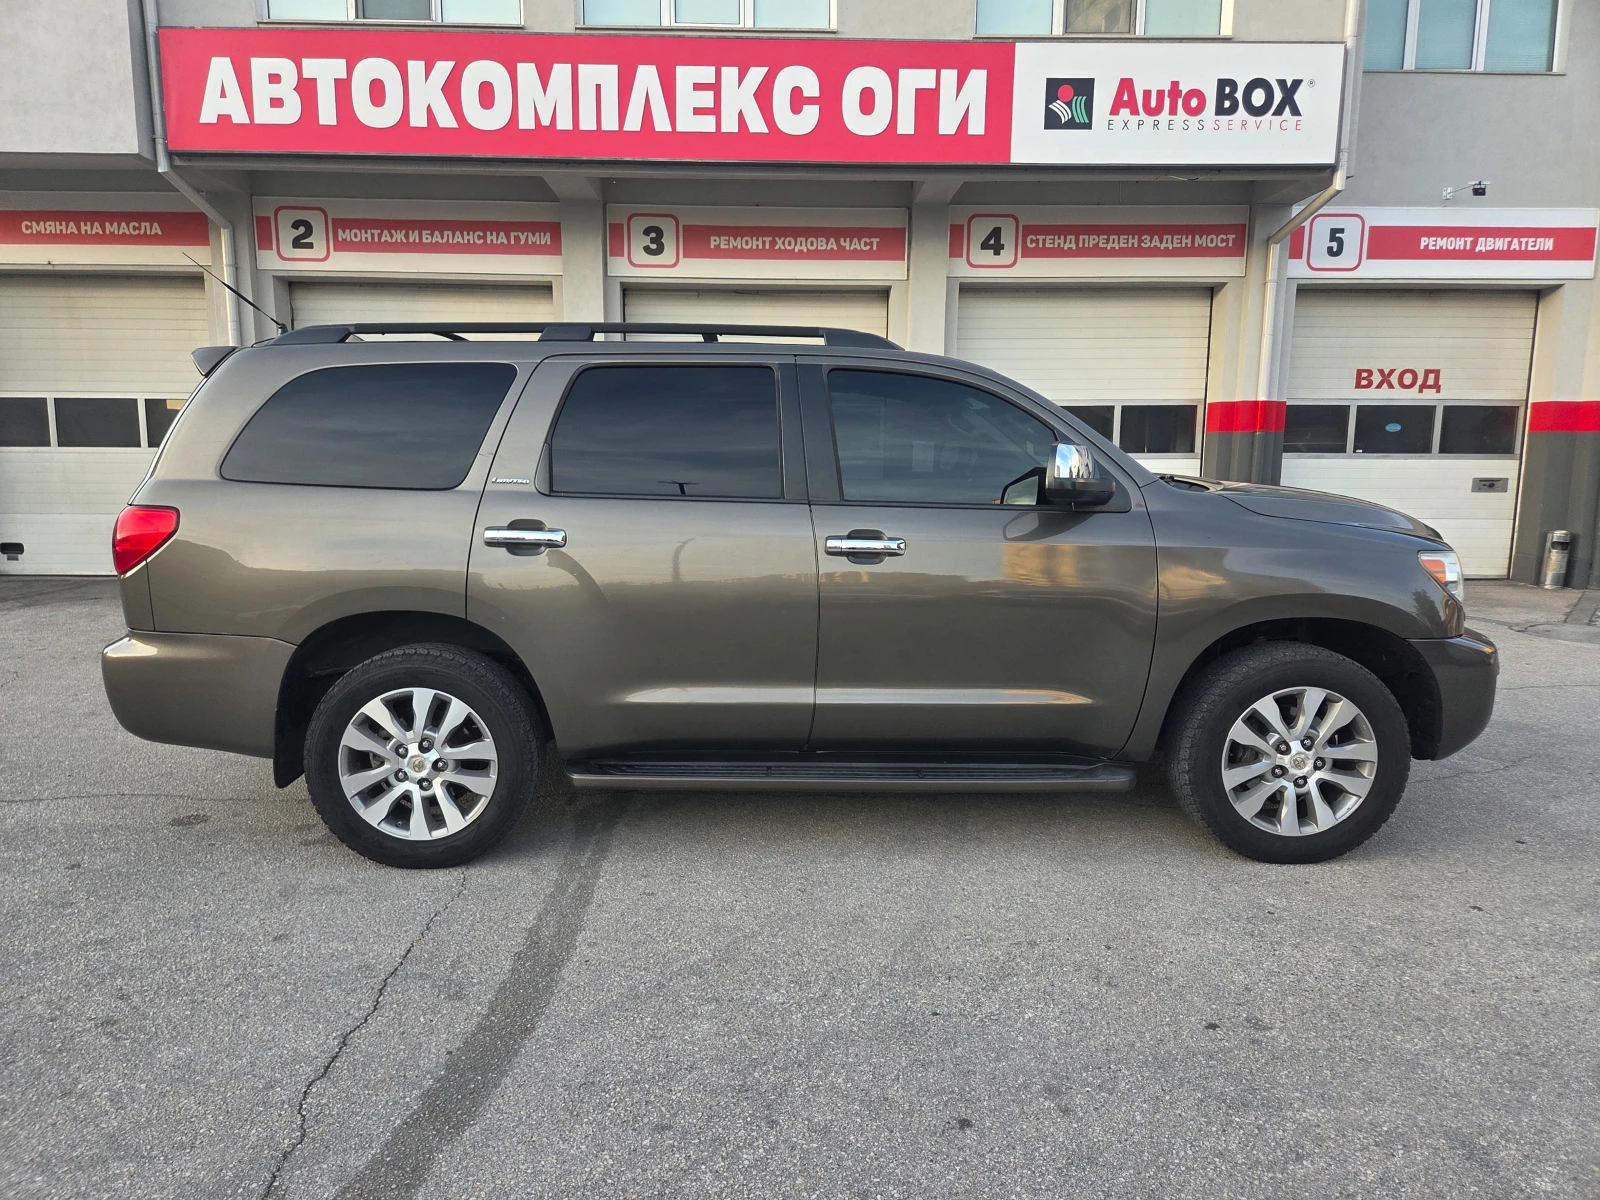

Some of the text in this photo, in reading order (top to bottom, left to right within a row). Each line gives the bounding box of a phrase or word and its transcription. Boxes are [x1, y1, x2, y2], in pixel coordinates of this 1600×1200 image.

[199, 55, 988, 137] АВТОКОМПЛЕКС ОГИ
[1109, 77, 1207, 117] Auto
[1214, 77, 1304, 118] BOX
[21, 221, 163, 236] СМЯНА НА МАСЛА
[290, 218, 314, 250] 2
[337, 228, 551, 245] МОНТАЖ И БАЛАНС НА ГУМИ
[642, 225, 666, 257] 3
[980, 226, 1005, 256] 4
[1026, 234, 1236, 250] СТЕНД ПРЕДЕН ЗАДЕН МОСТ
[1326, 227, 1345, 257] 5
[710, 235, 880, 252] РЕМОНТ ХОДОВА ЧАСТ
[1420, 236, 1554, 252] РЕМОНТ ДВИГАТЕЛИ
[1354, 368, 1441, 394] ВХОД
